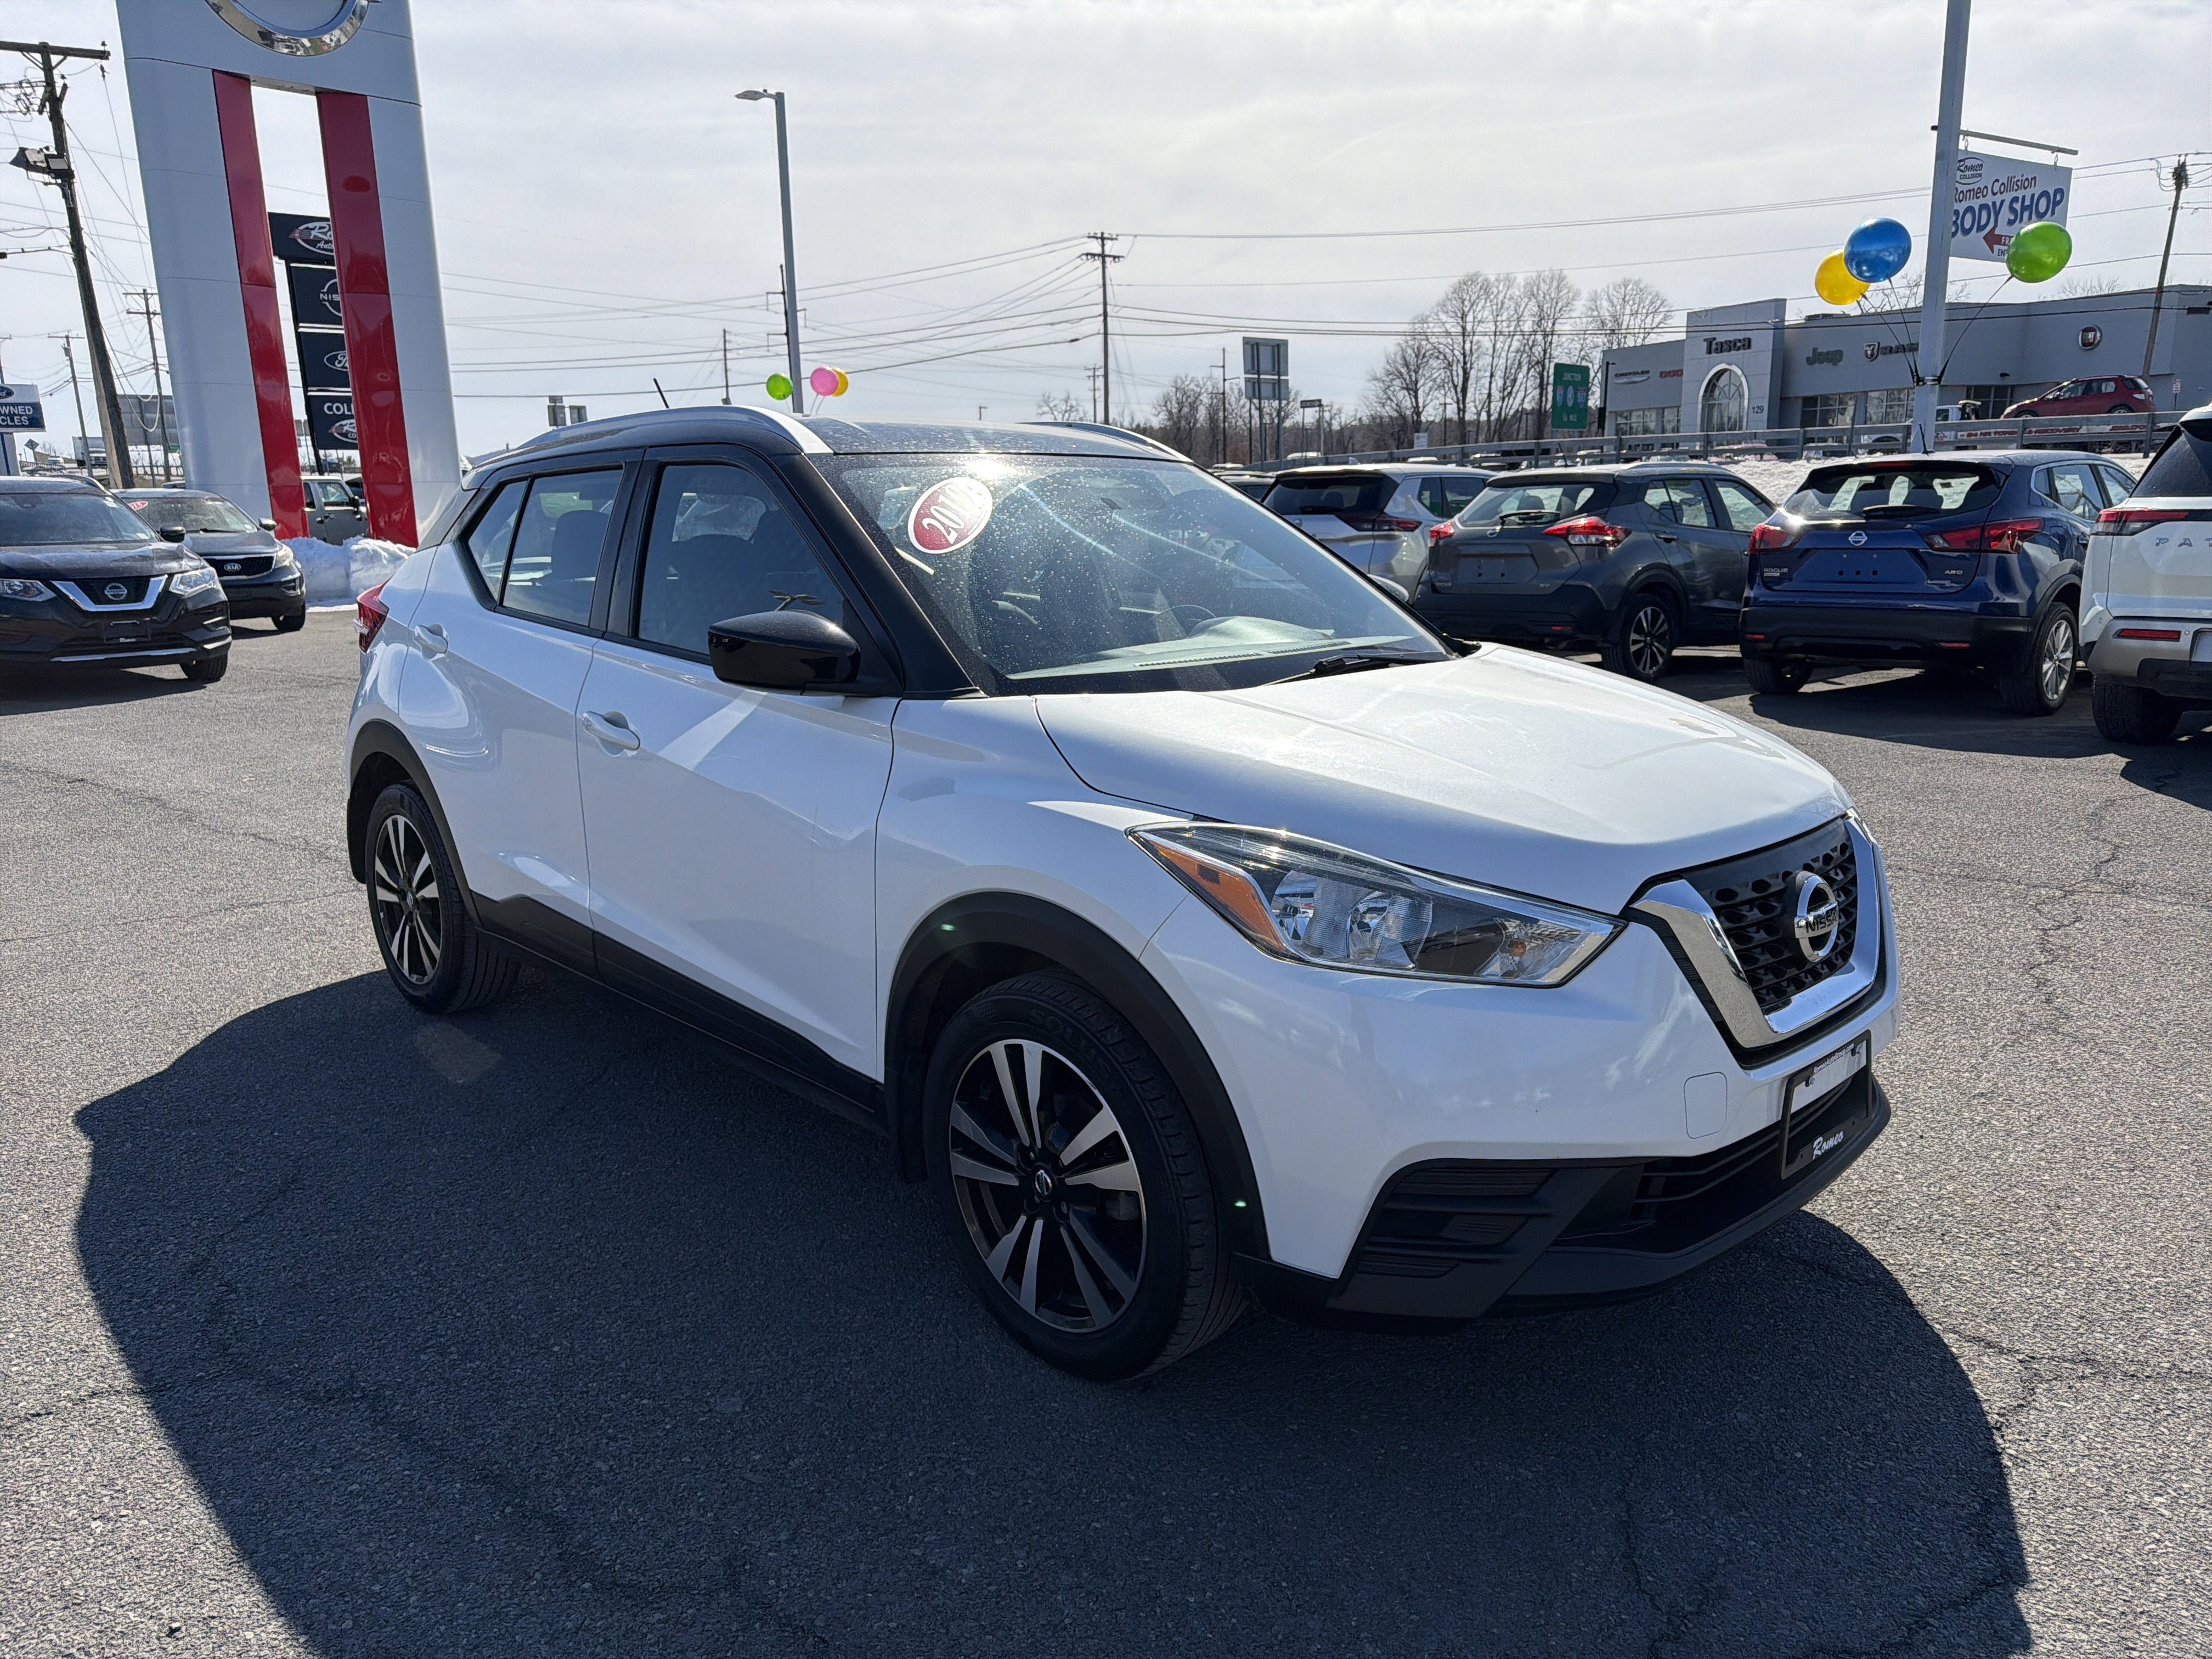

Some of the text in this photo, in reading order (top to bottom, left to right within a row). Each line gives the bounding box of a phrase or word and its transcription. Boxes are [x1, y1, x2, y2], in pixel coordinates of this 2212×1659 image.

[1957, 160, 1984, 173] Romeo
[1991, 173, 2038, 196] Collision
[2006, 188, 2065, 226] SHOP
[319, 293, 340, 301] NIS
[1703, 337, 1752, 355] Tasca
[1659, 369, 1683, 379] DOD
[0, 405, 33, 415] WNED
[1752, 405, 1764, 414] 129
[0, 416, 29, 425] CLES
[1812, 1130, 1844, 1161] Romeo
